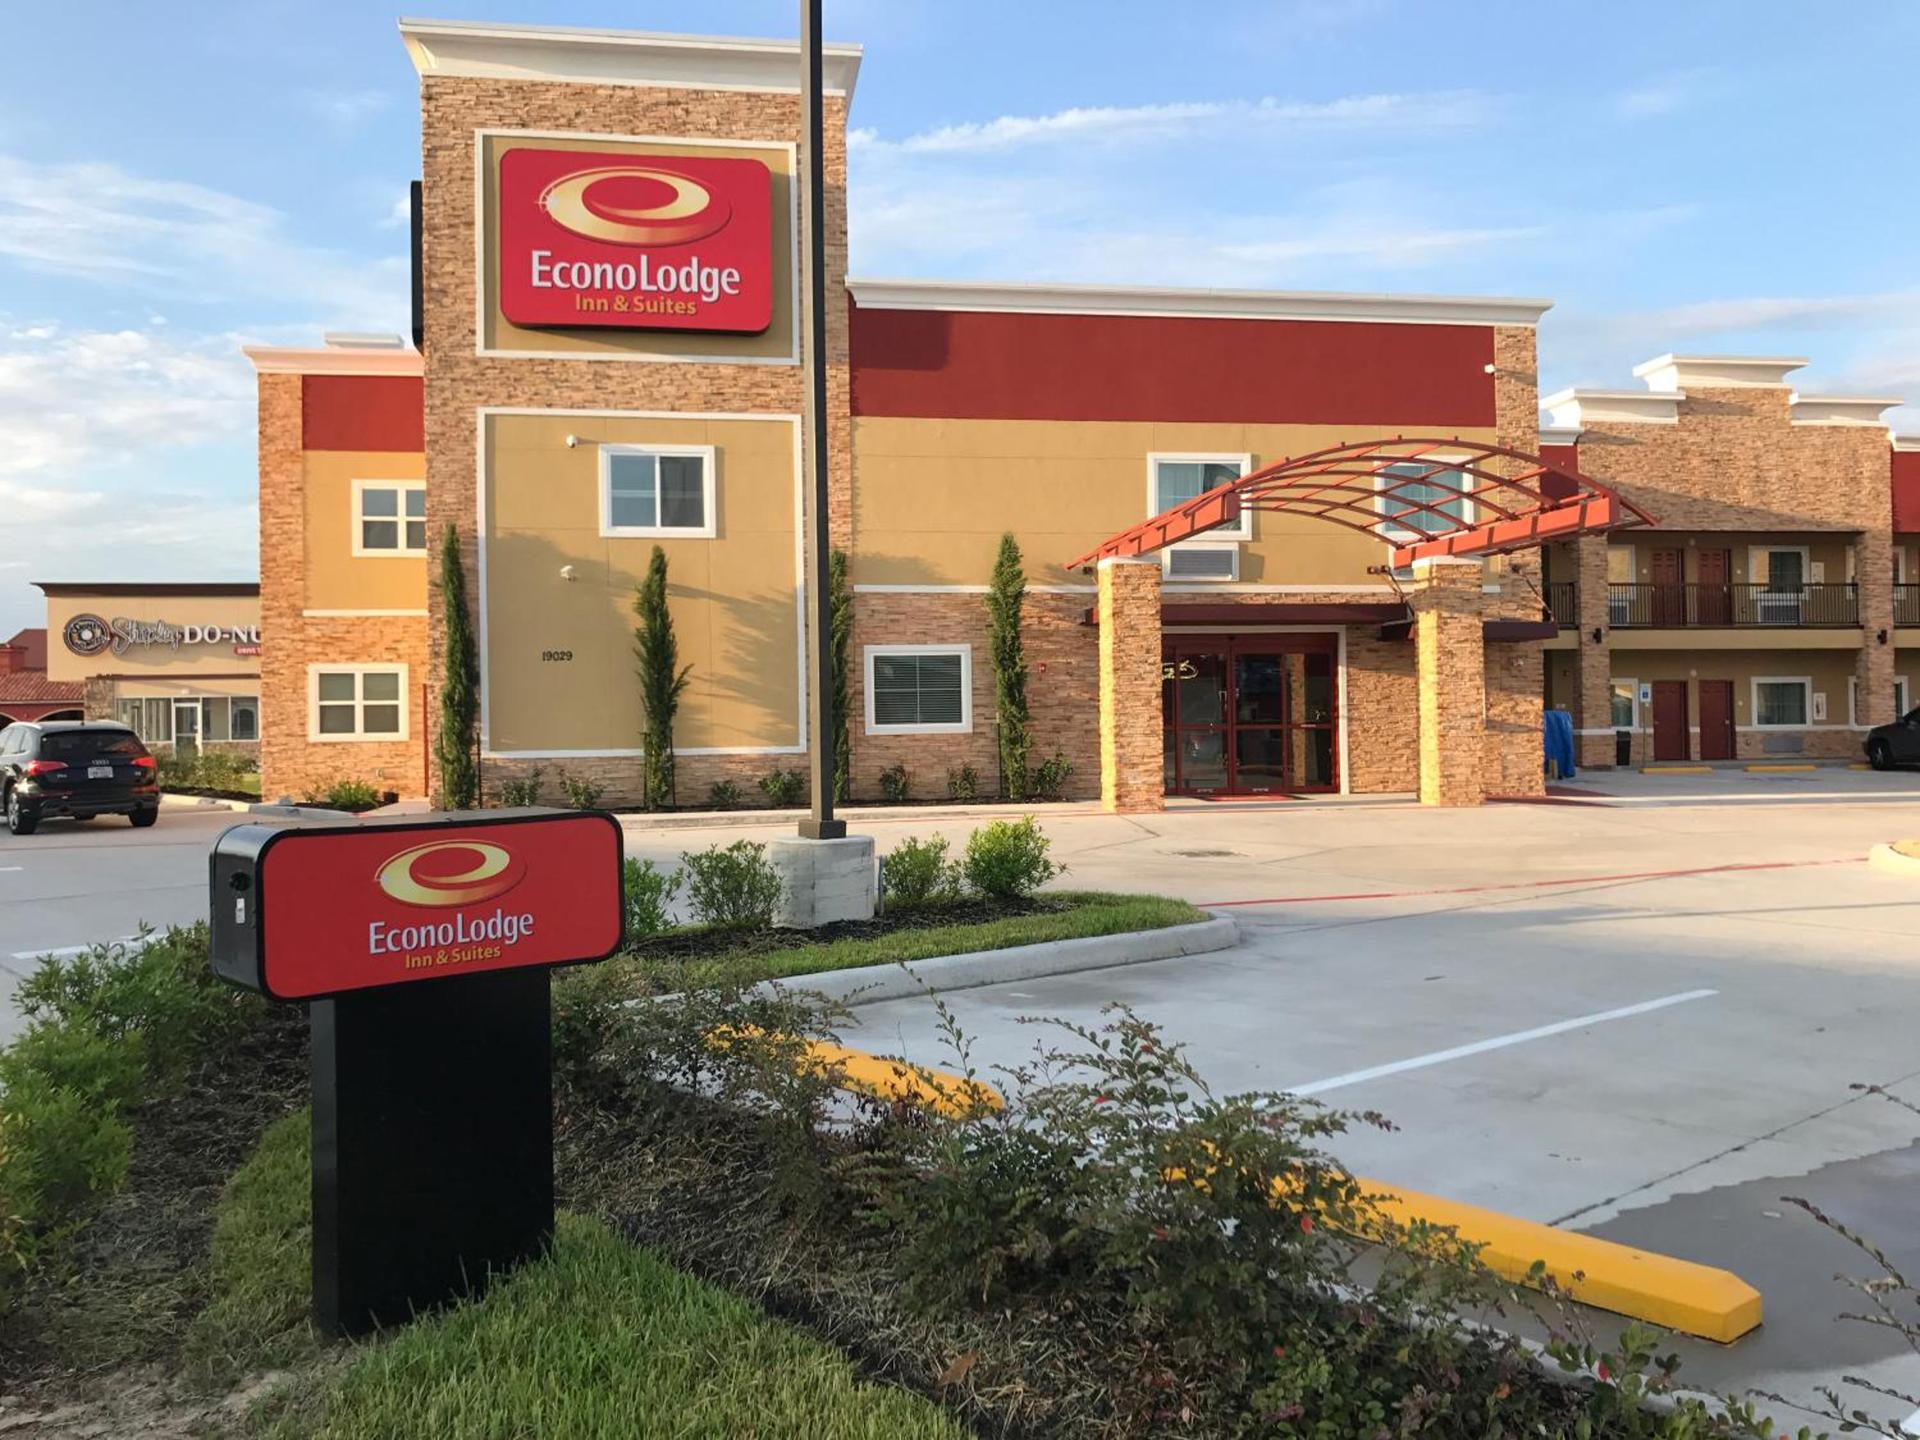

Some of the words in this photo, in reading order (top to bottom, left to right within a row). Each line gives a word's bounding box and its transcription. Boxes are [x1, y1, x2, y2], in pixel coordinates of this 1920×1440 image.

[575, 293, 609, 312] Inn
[613, 295, 629, 312] &
[633, 296, 697, 315] Suites
[112, 618, 179, 653] Shipley
[542, 650, 573, 662] 19029
[404, 954, 432, 969] Inn
[436, 950, 449, 964] &
[452, 945, 502, 962] Suites
